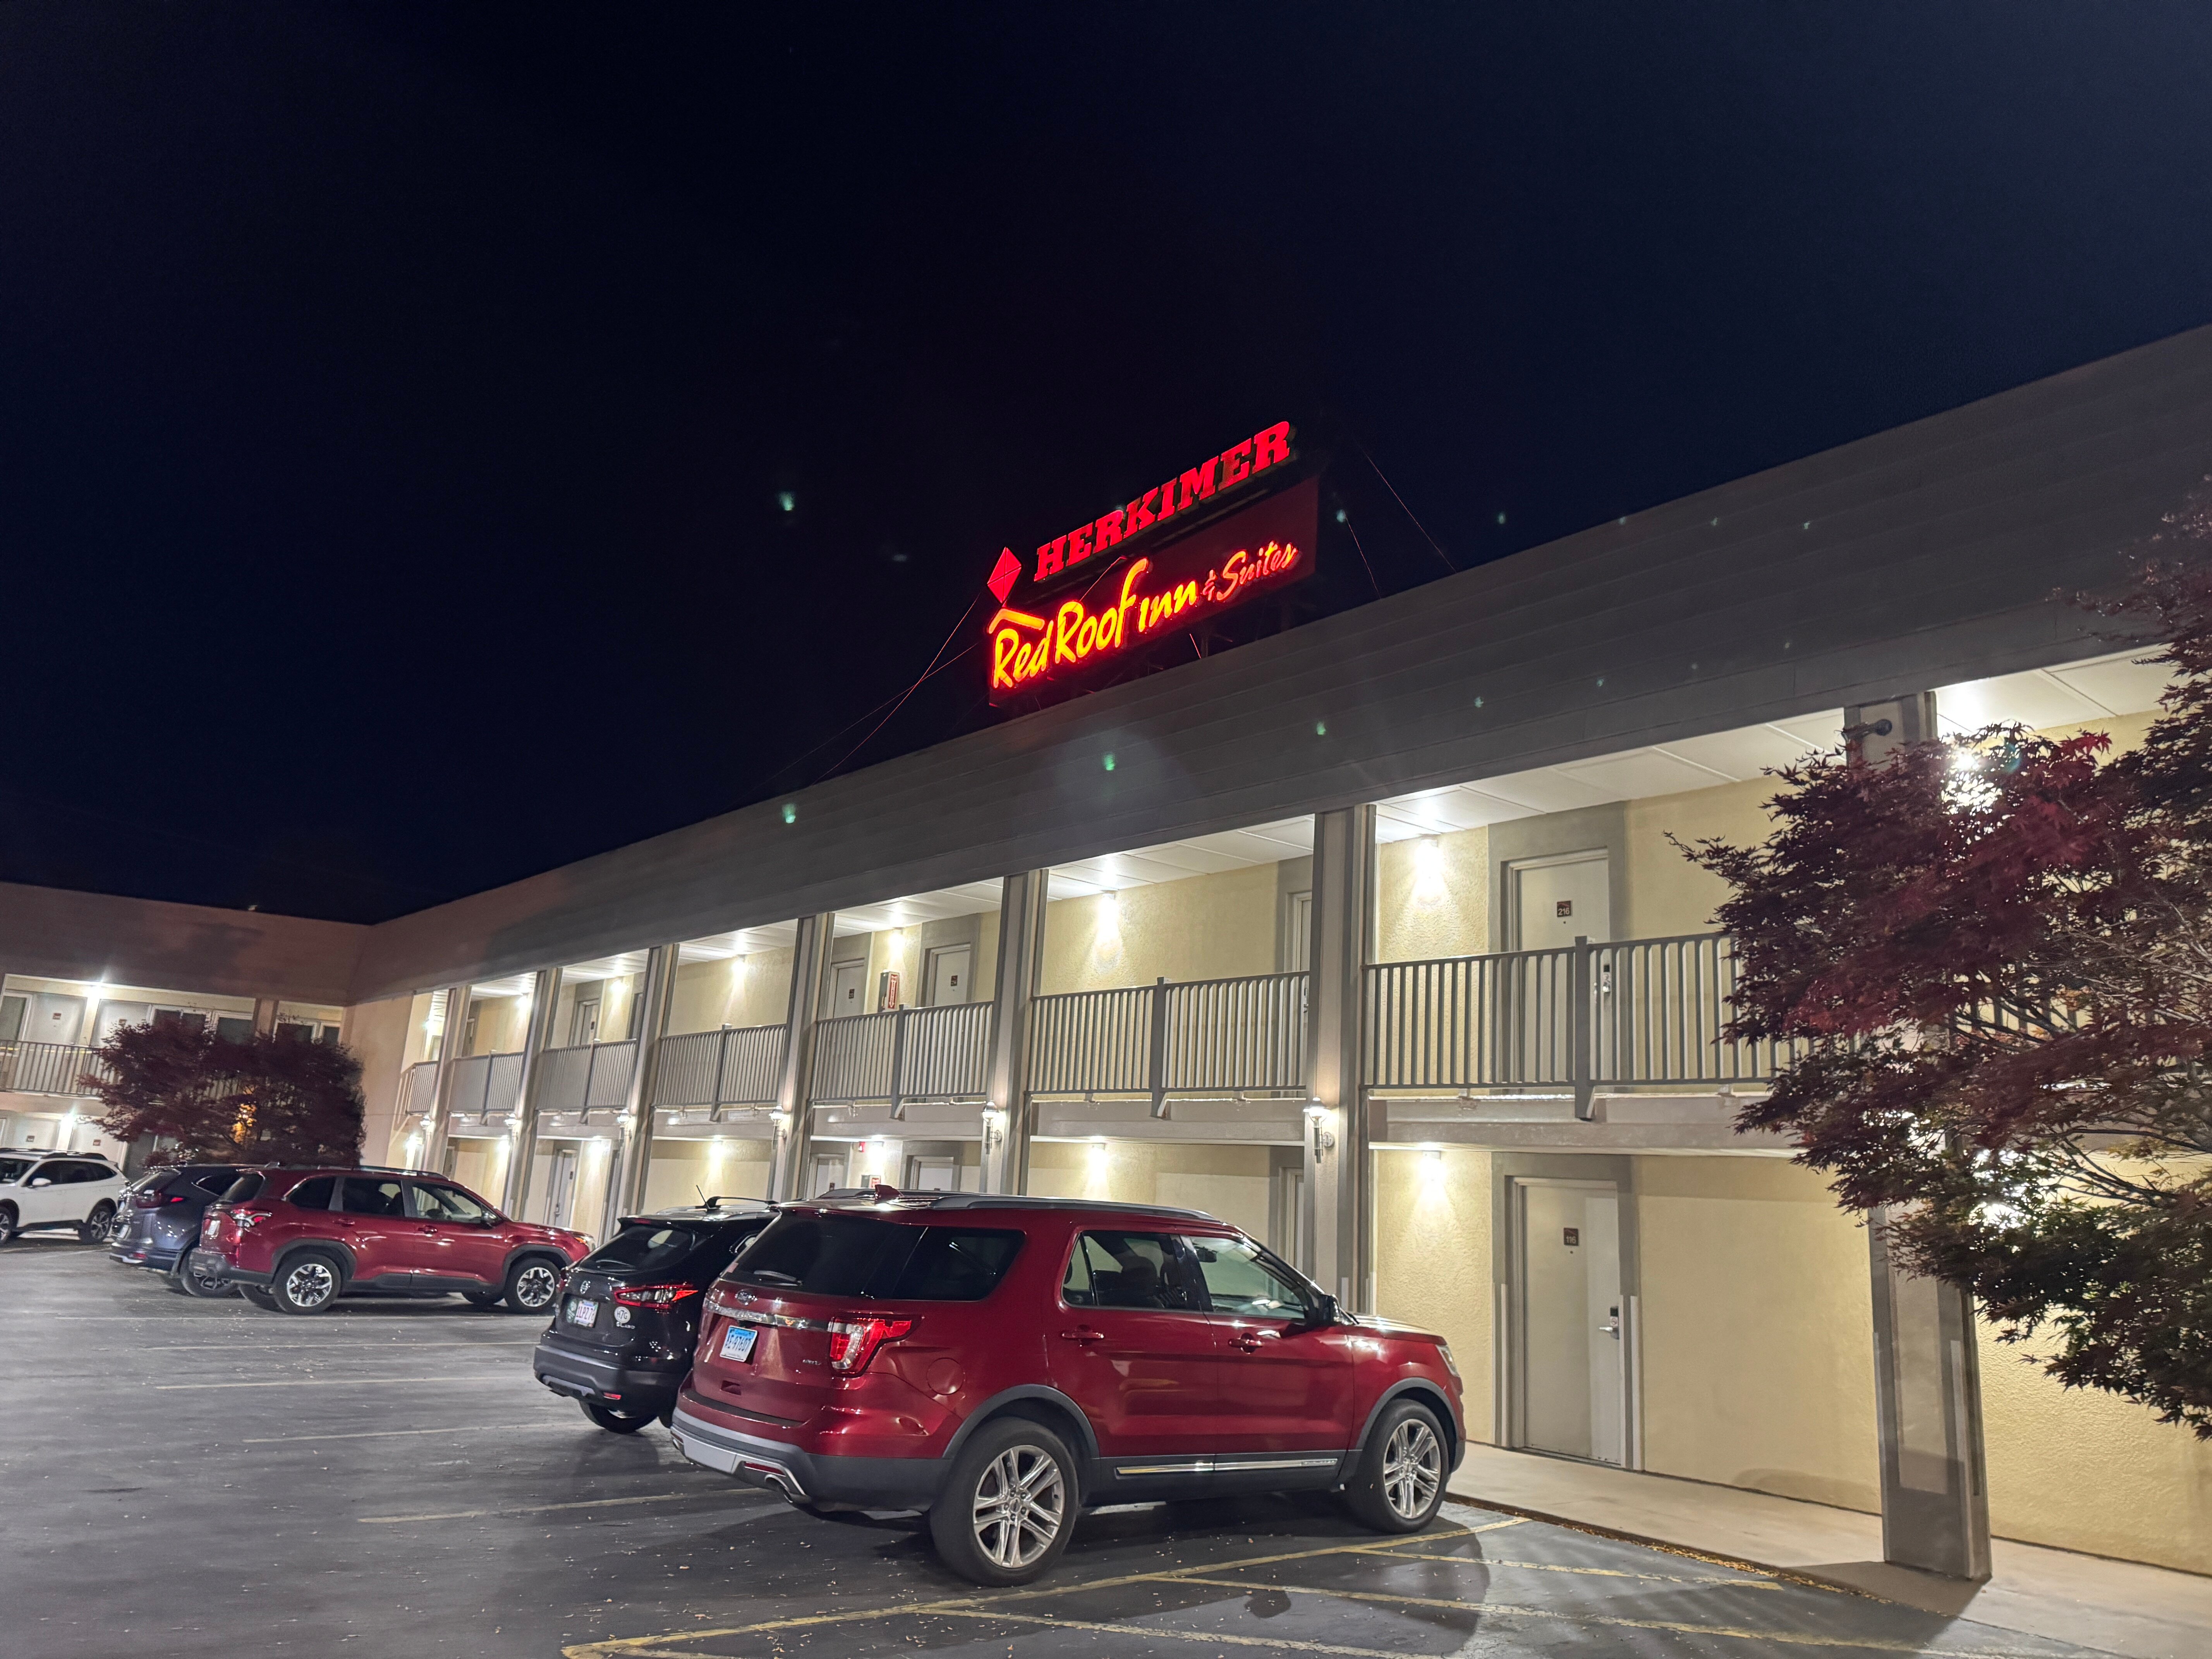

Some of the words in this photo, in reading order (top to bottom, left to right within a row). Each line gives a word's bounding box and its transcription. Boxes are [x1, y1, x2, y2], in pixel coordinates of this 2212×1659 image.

[1034, 421, 1290, 581] HERKIMER
[993, 620, 1054, 689] Red
[1054, 557, 1149, 664] Roof
[1202, 569, 1217, 601] &
[1216, 540, 1298, 602] Suites
[1558, 907, 1570, 915] 216
[1566, 1235, 1577, 1244] 116
